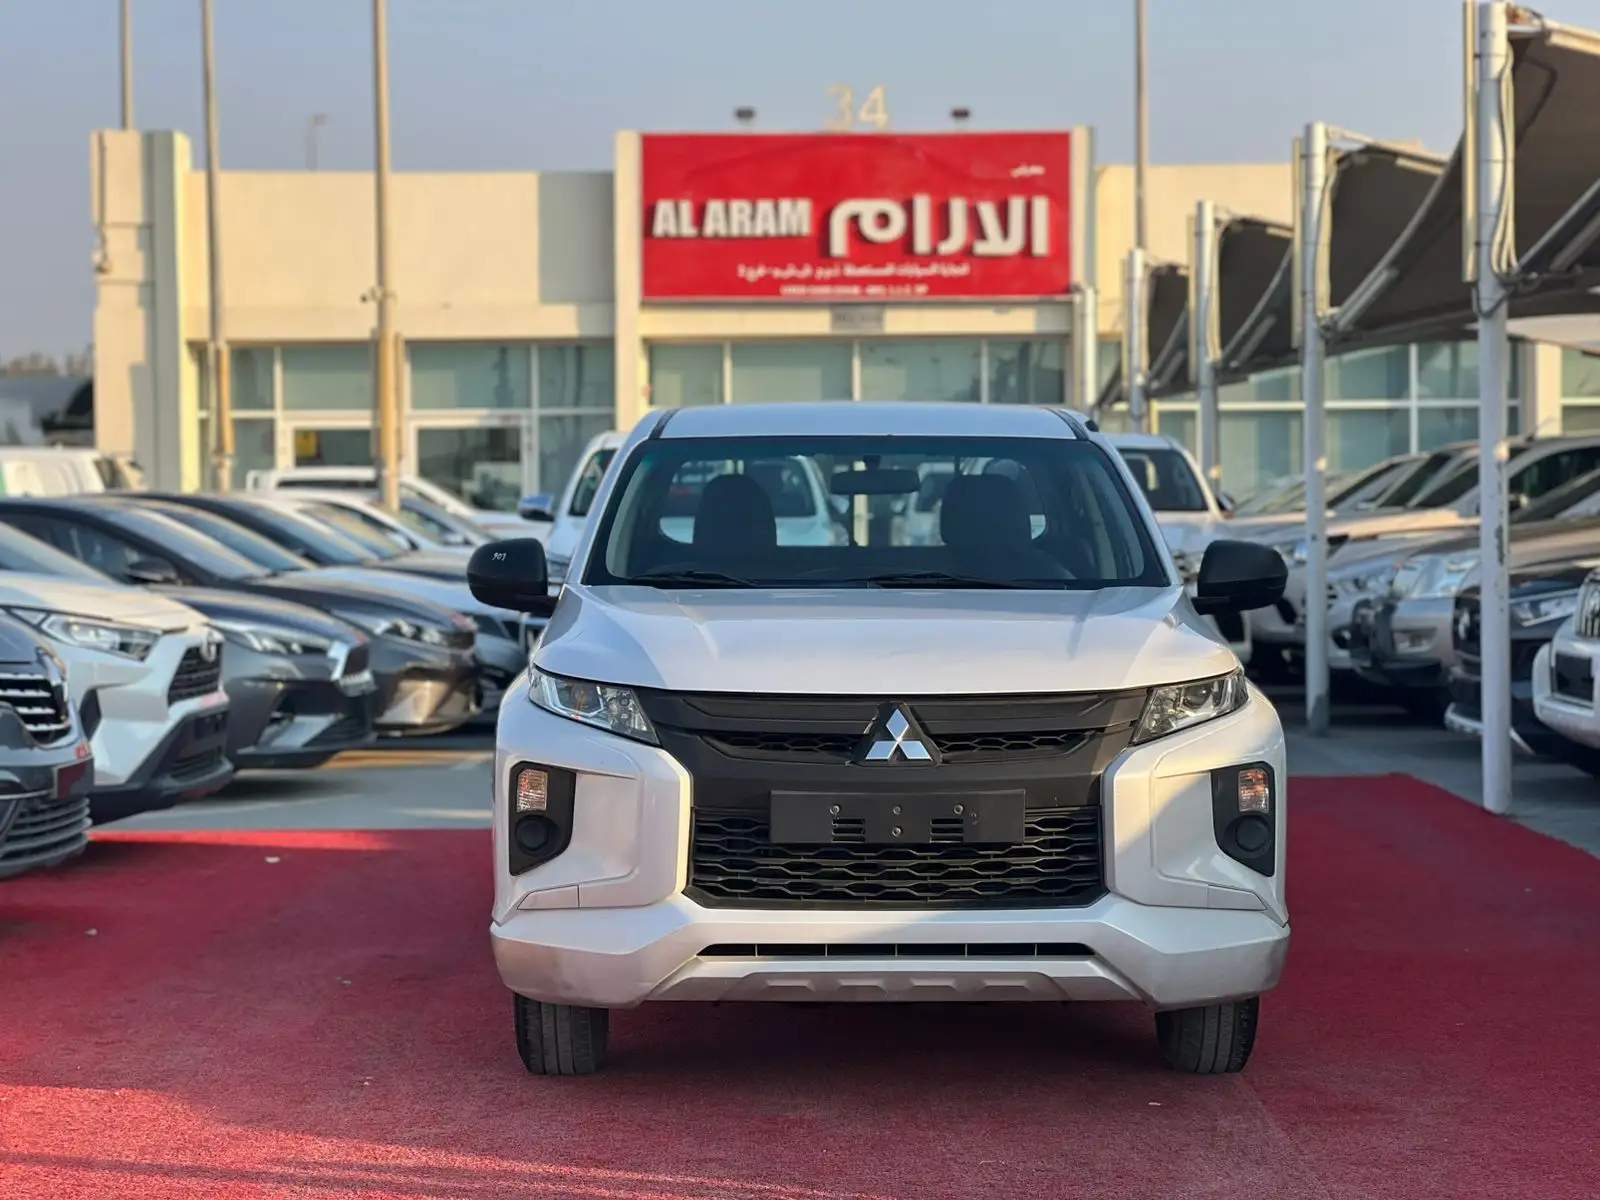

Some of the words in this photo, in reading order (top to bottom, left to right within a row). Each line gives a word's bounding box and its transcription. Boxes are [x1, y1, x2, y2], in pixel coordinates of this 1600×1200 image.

[822, 82, 888, 131] 34
[652, 198, 697, 237] AL
[702, 198, 812, 237] ARAM
